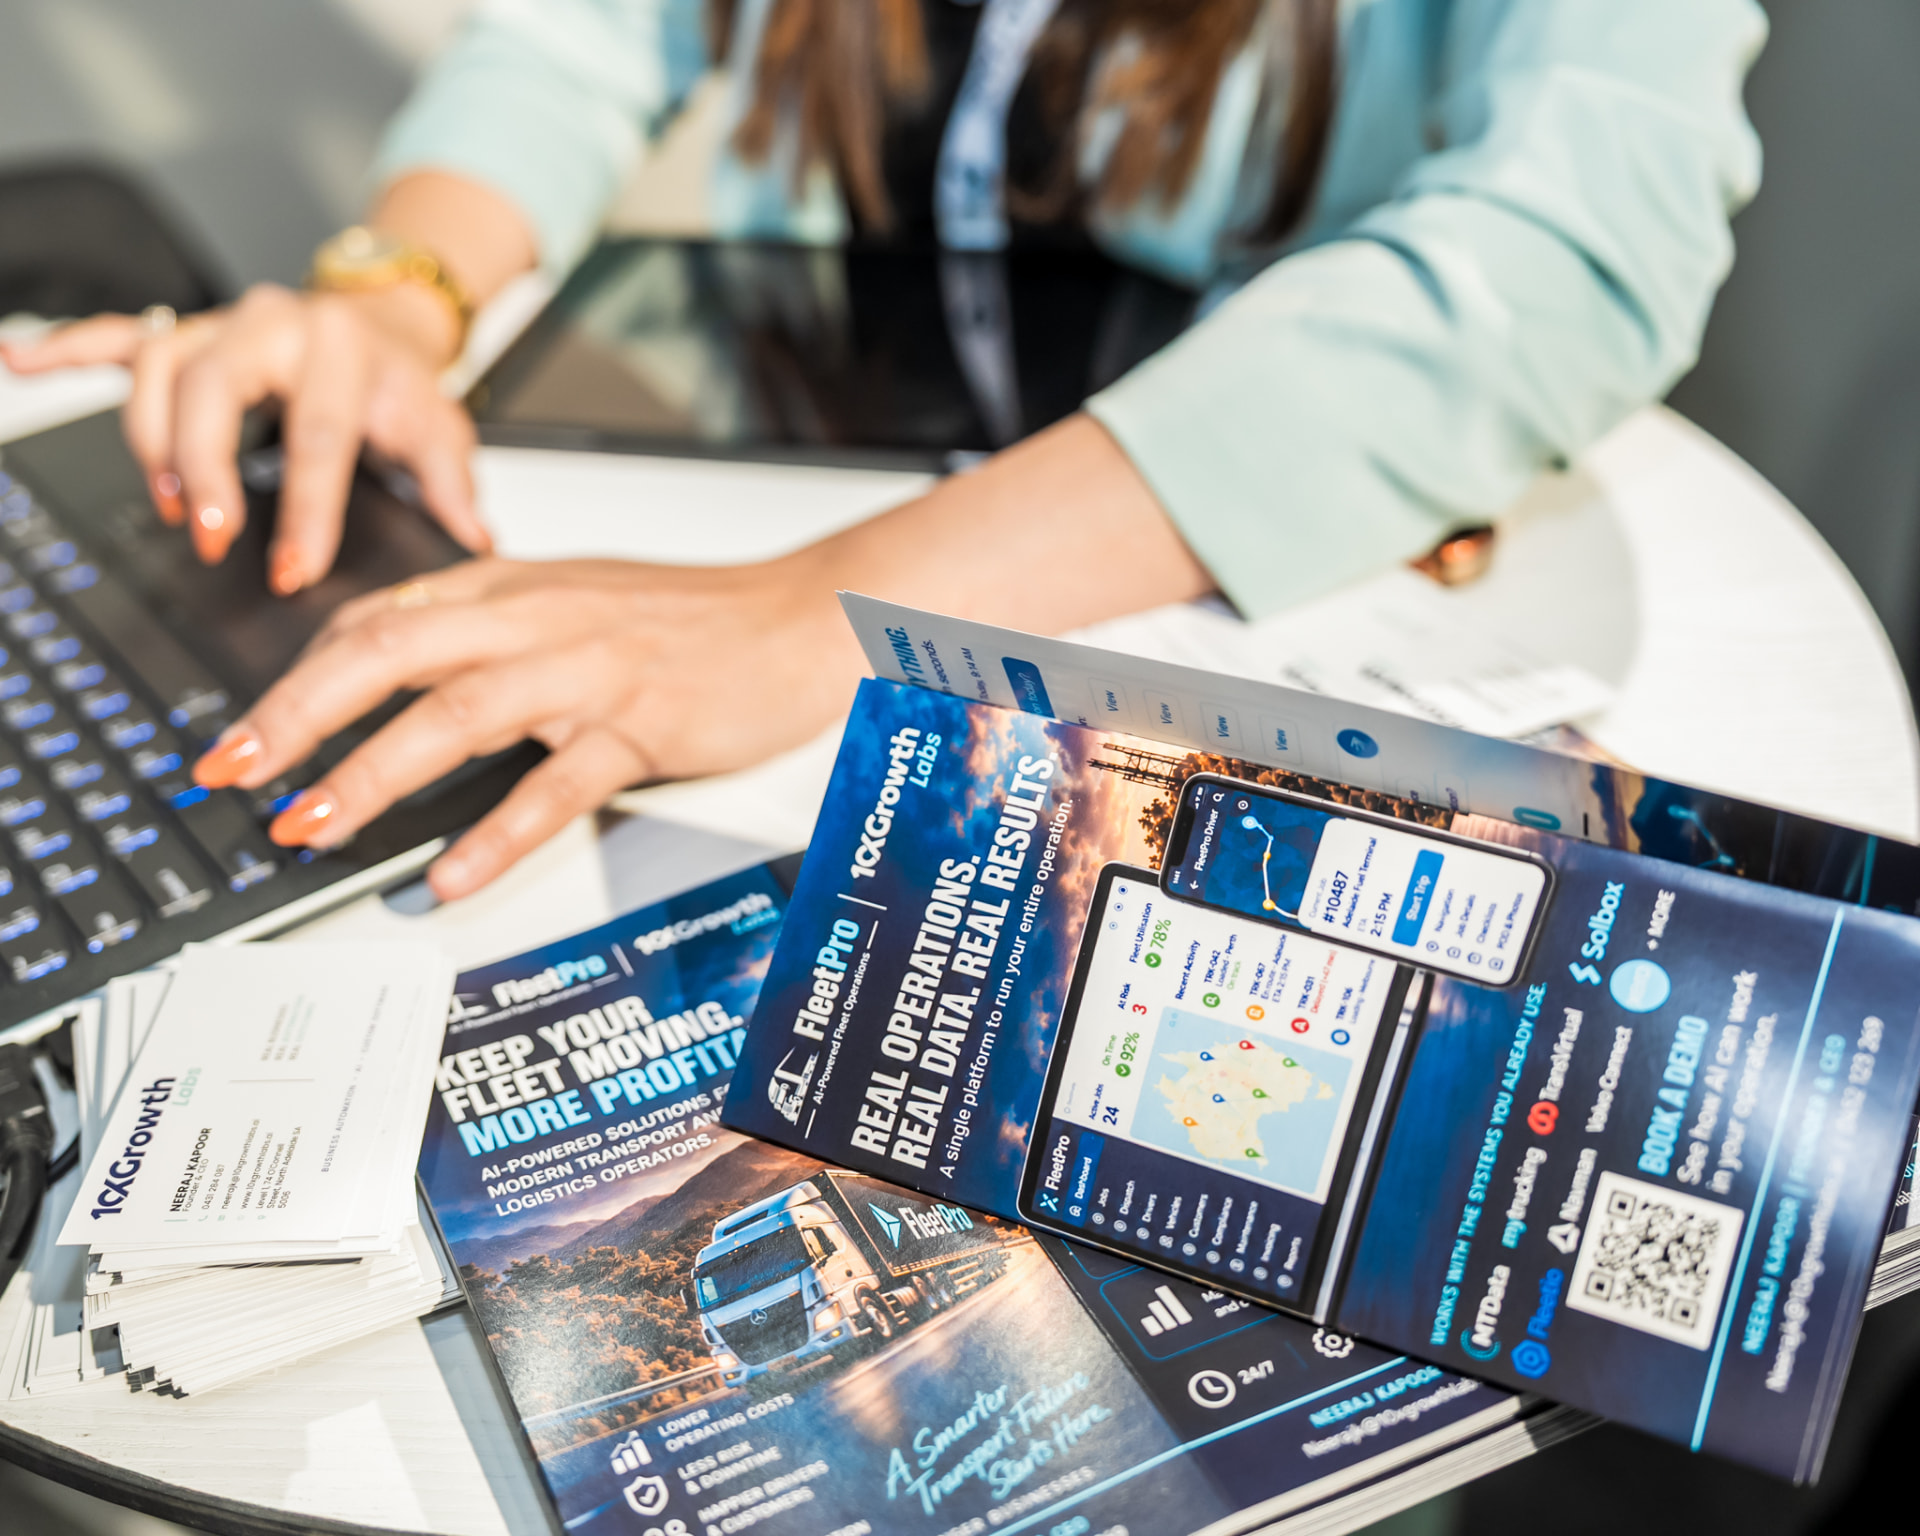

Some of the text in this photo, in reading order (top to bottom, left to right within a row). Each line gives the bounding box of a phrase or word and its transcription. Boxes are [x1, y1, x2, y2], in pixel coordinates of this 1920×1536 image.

[920, 639, 952, 686] seconds.
[960, 648, 974, 662] AM
[1105, 690, 1119, 712] View
[1159, 703, 1173, 725] View
[1216, 716, 1230, 738] View
[908, 733, 942, 788] Labs
[1275, 729, 1289, 751] View
[1193, 809, 1219, 872] FleetPro Driver
[1323, 871, 1349, 923] #10487
[1342, 838, 1377, 928] Adelaide Fuel Terminal
[1405, 875, 1431, 921] Start Trip
[1128, 903, 1153, 964] Fleet Utilisation
[1149, 920, 1172, 949] 78%
[1356, 918, 1368, 933] ETA
[1369, 893, 1393, 938] 2:15 PM
[1581, 882, 1624, 960] Solbox
[1647, 890, 1675, 937] MORE
[490, 954, 610, 1010] FleetPro
[794, 920, 859, 1040] FleetPro
[891, 752, 1060, 1168] REAL DATA. REAL RESULTS.
[1174, 940, 1201, 1000] Recent Activity
[1203, 950, 1221, 983] TRK-042
[1215, 934, 1237, 988] Loaded Perth
[851, 858, 979, 1155] REAL OPERATIONS.
[935, 795, 1073, 1180] A single platform to run your entire operation.
[1117, 984, 1131, 1010] At Risk
[1131, 1004, 1148, 1016] 3
[435, 1036, 533, 1095] KEEP
[538, 997, 653, 1055] YOUR
[812, 953, 871, 1105] AI-Powered Fleet Operations
[1101, 1035, 1117, 1067] On Time
[1119, 1033, 1140, 1062] 92%
[443, 1059, 564, 1122] FLEET
[565, 1003, 741, 1081] MOVING.
[1598, 1026, 1633, 1091] Connect
[1676, 972, 1757, 1185] See how AI can work
[171, 1068, 202, 1107] Labs
[1088, 1084, 1104, 1120] Active Jobs
[1638, 1016, 1709, 1175] BOOK A DEMO
[1706, 1006, 1783, 1194] in your operation.
[320, 1085, 356, 1173] BUSINESS AUTOMATION
[459, 1088, 590, 1155] MORE
[481, 1094, 711, 1181] AI-POWERED SOLUTIONS
[1101, 1106, 1120, 1126] 24
[169, 1128, 211, 1212] NEERAJ KAPOOR
[179, 1157, 210, 1212] Founder CEO
[207, 1179, 220, 1193] 284
[255, 1143, 285, 1209] Level 74 O'Connell
[265, 1126, 302, 1209] Street, North Adelaide SA
[487, 1122, 686, 1199] MODERN TRANSPORT
[495, 1134, 721, 1216] LOGISTICS OPERATORS.
[1044, 1136, 1070, 1191] FleetPro
[1074, 1157, 1093, 1200] Dashboard
[1430, 983, 1547, 1345] WORKS WITH THE SYSTEMS YOU ALREADY USE.
[1559, 1149, 1597, 1222] Navman
[899, 1203, 976, 1242] FleetPro
[1097, 1188, 1110, 1208] Jobs
[1118, 1181, 1135, 1215] Dispatch
[1141, 1194, 1158, 1223] Drivers
[1165, 1197, 1182, 1230] Vehicles
[1188, 1194, 1209, 1238] Customers
[1211, 1197, 1233, 1246] Compliance
[1502, 1148, 1547, 1248] mytrucking
[1235, 1201, 1258, 1254] Maintenance
[1260, 1224, 1282, 1262] Invoicing
[1743, 1278, 1778, 1353] NEERAJ
[1765, 1196, 1802, 1274] KAPOOR
[1471, 1266, 1510, 1347] MTData
[1236, 1360, 1276, 1386] 24/7
[657, 1409, 710, 1437] LOWER
[665, 1393, 794, 1452] OPERATING COSTS
[1307, 1391, 1377, 1430] NEERAJ
[677, 1441, 753, 1480] LESS RISK
[699, 1447, 781, 1488] DOWNTIME
[884, 1383, 1011, 1501] A Smarter
[904, 1370, 1092, 1517] Transport Future
[986, 1437, 1060, 1501] Starts
[763, 1460, 829, 1495] DRIVERS
